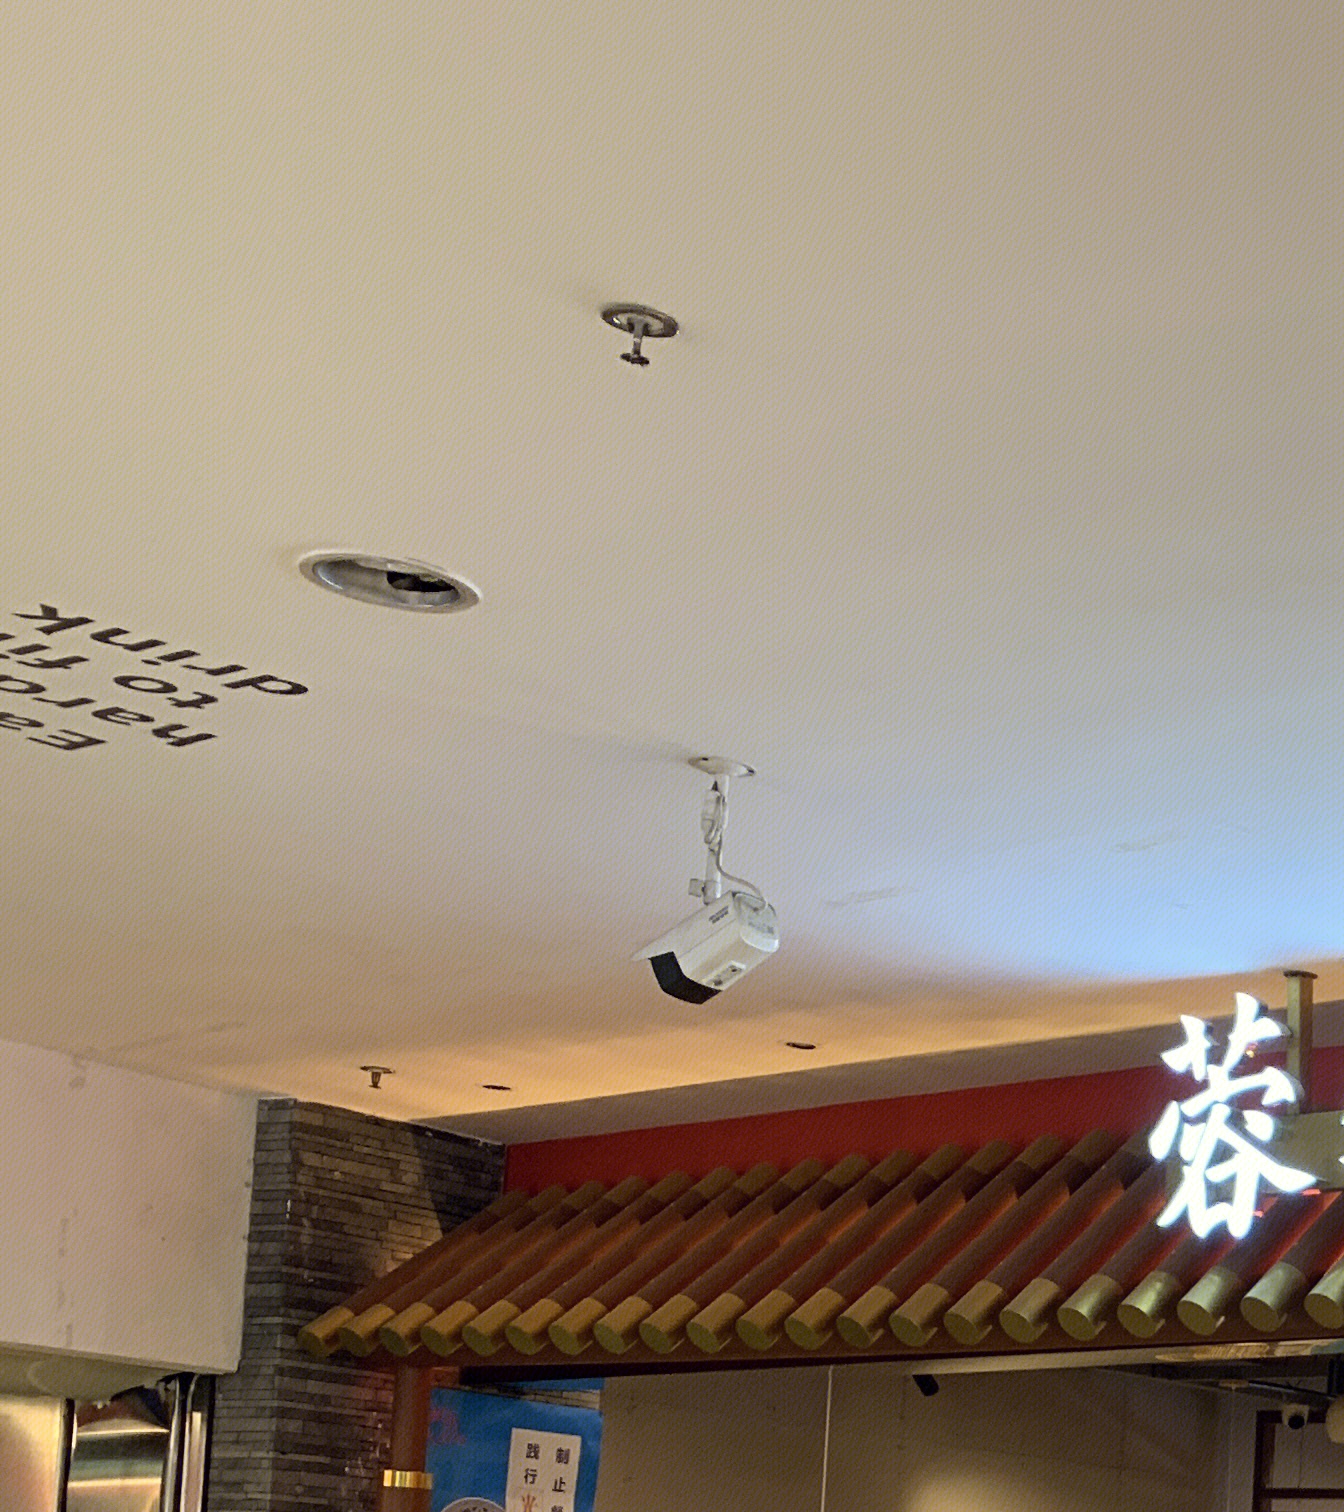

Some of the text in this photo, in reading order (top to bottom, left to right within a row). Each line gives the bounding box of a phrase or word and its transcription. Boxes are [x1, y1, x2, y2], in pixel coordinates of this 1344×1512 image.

[0, 632, 218, 709] to fi
[12, 603, 309, 696] drink
